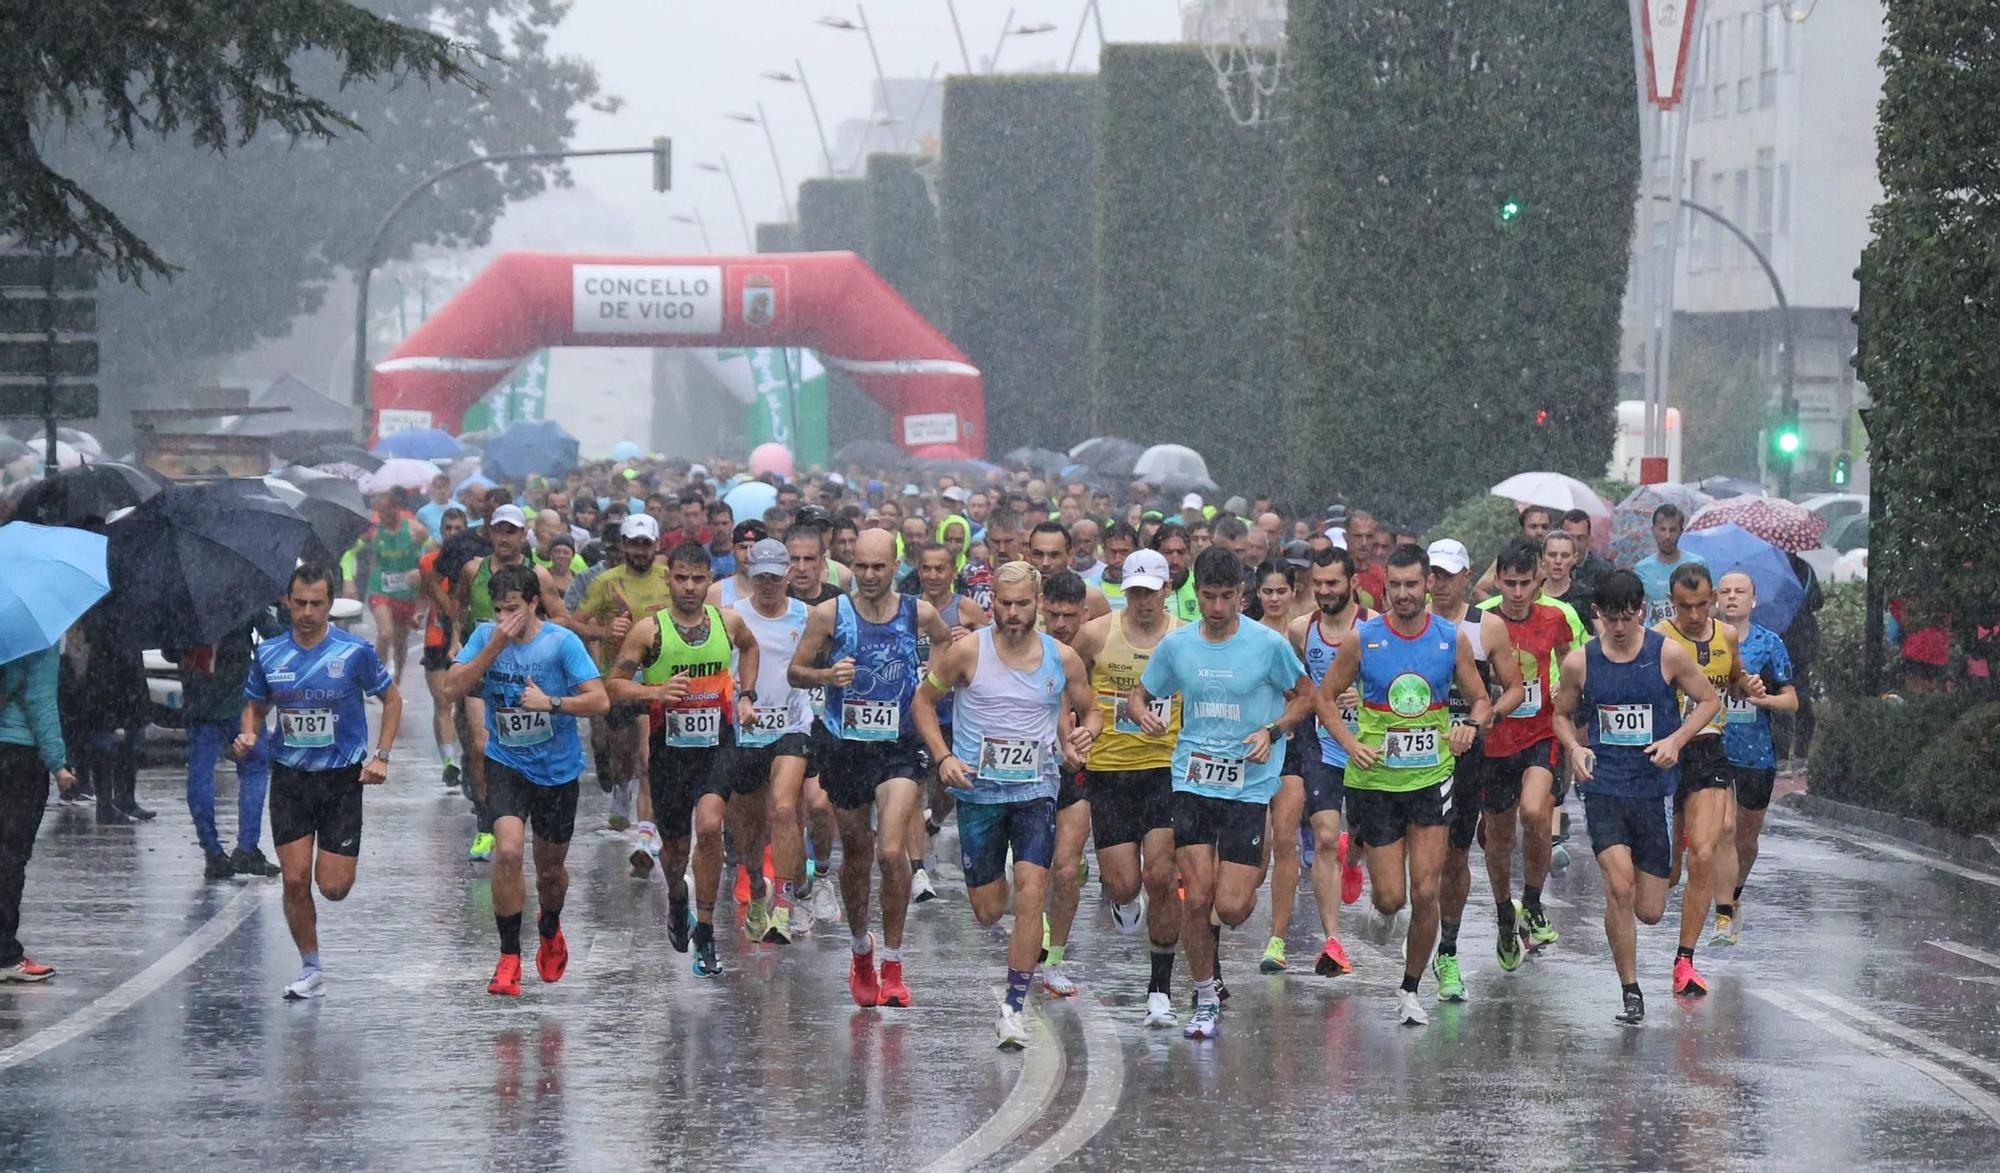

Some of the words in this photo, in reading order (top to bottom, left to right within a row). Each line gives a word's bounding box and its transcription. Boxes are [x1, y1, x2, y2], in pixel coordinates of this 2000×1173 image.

[584, 278, 709, 296] CONCELLO
[600, 302, 629, 318] DE
[639, 302, 695, 319] VIGO
[294, 716, 327, 733] 787
[510, 712, 546, 732] 874
[684, 715, 714, 732] 801
[754, 714, 786, 730] 428
[861, 708, 892, 726] 541
[1614, 713, 1645, 729] 901
[1403, 733, 1434, 752] 753
[1000, 747, 1033, 765] 724
[1204, 763, 1238, 782] 775
